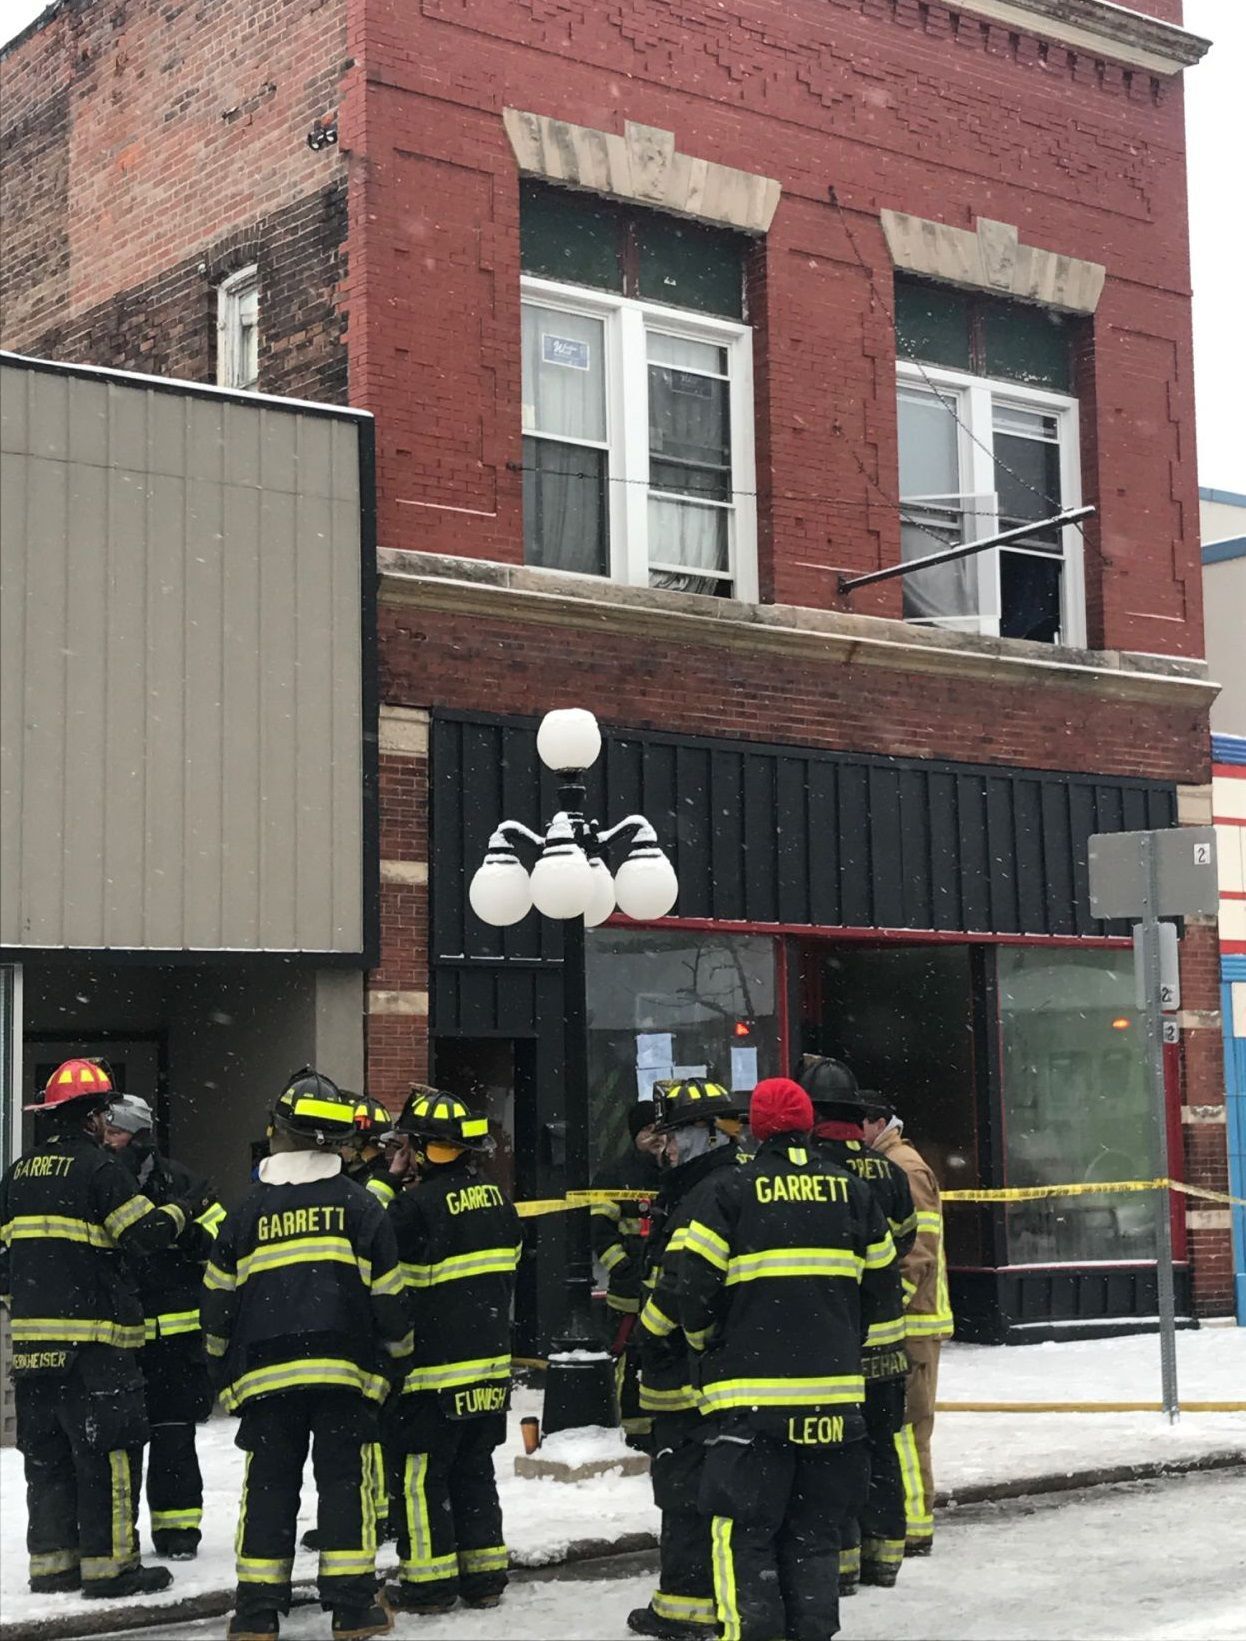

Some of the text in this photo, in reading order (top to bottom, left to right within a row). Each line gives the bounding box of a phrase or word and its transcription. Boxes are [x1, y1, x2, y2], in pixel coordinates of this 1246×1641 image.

[13, 1155, 75, 1180] GARRETT
[445, 1184, 504, 1215] GARRETT
[755, 1174, 849, 1203] GARRETT
[258, 1206, 345, 1241] GARRETT
[789, 1415, 844, 1445] LEON
